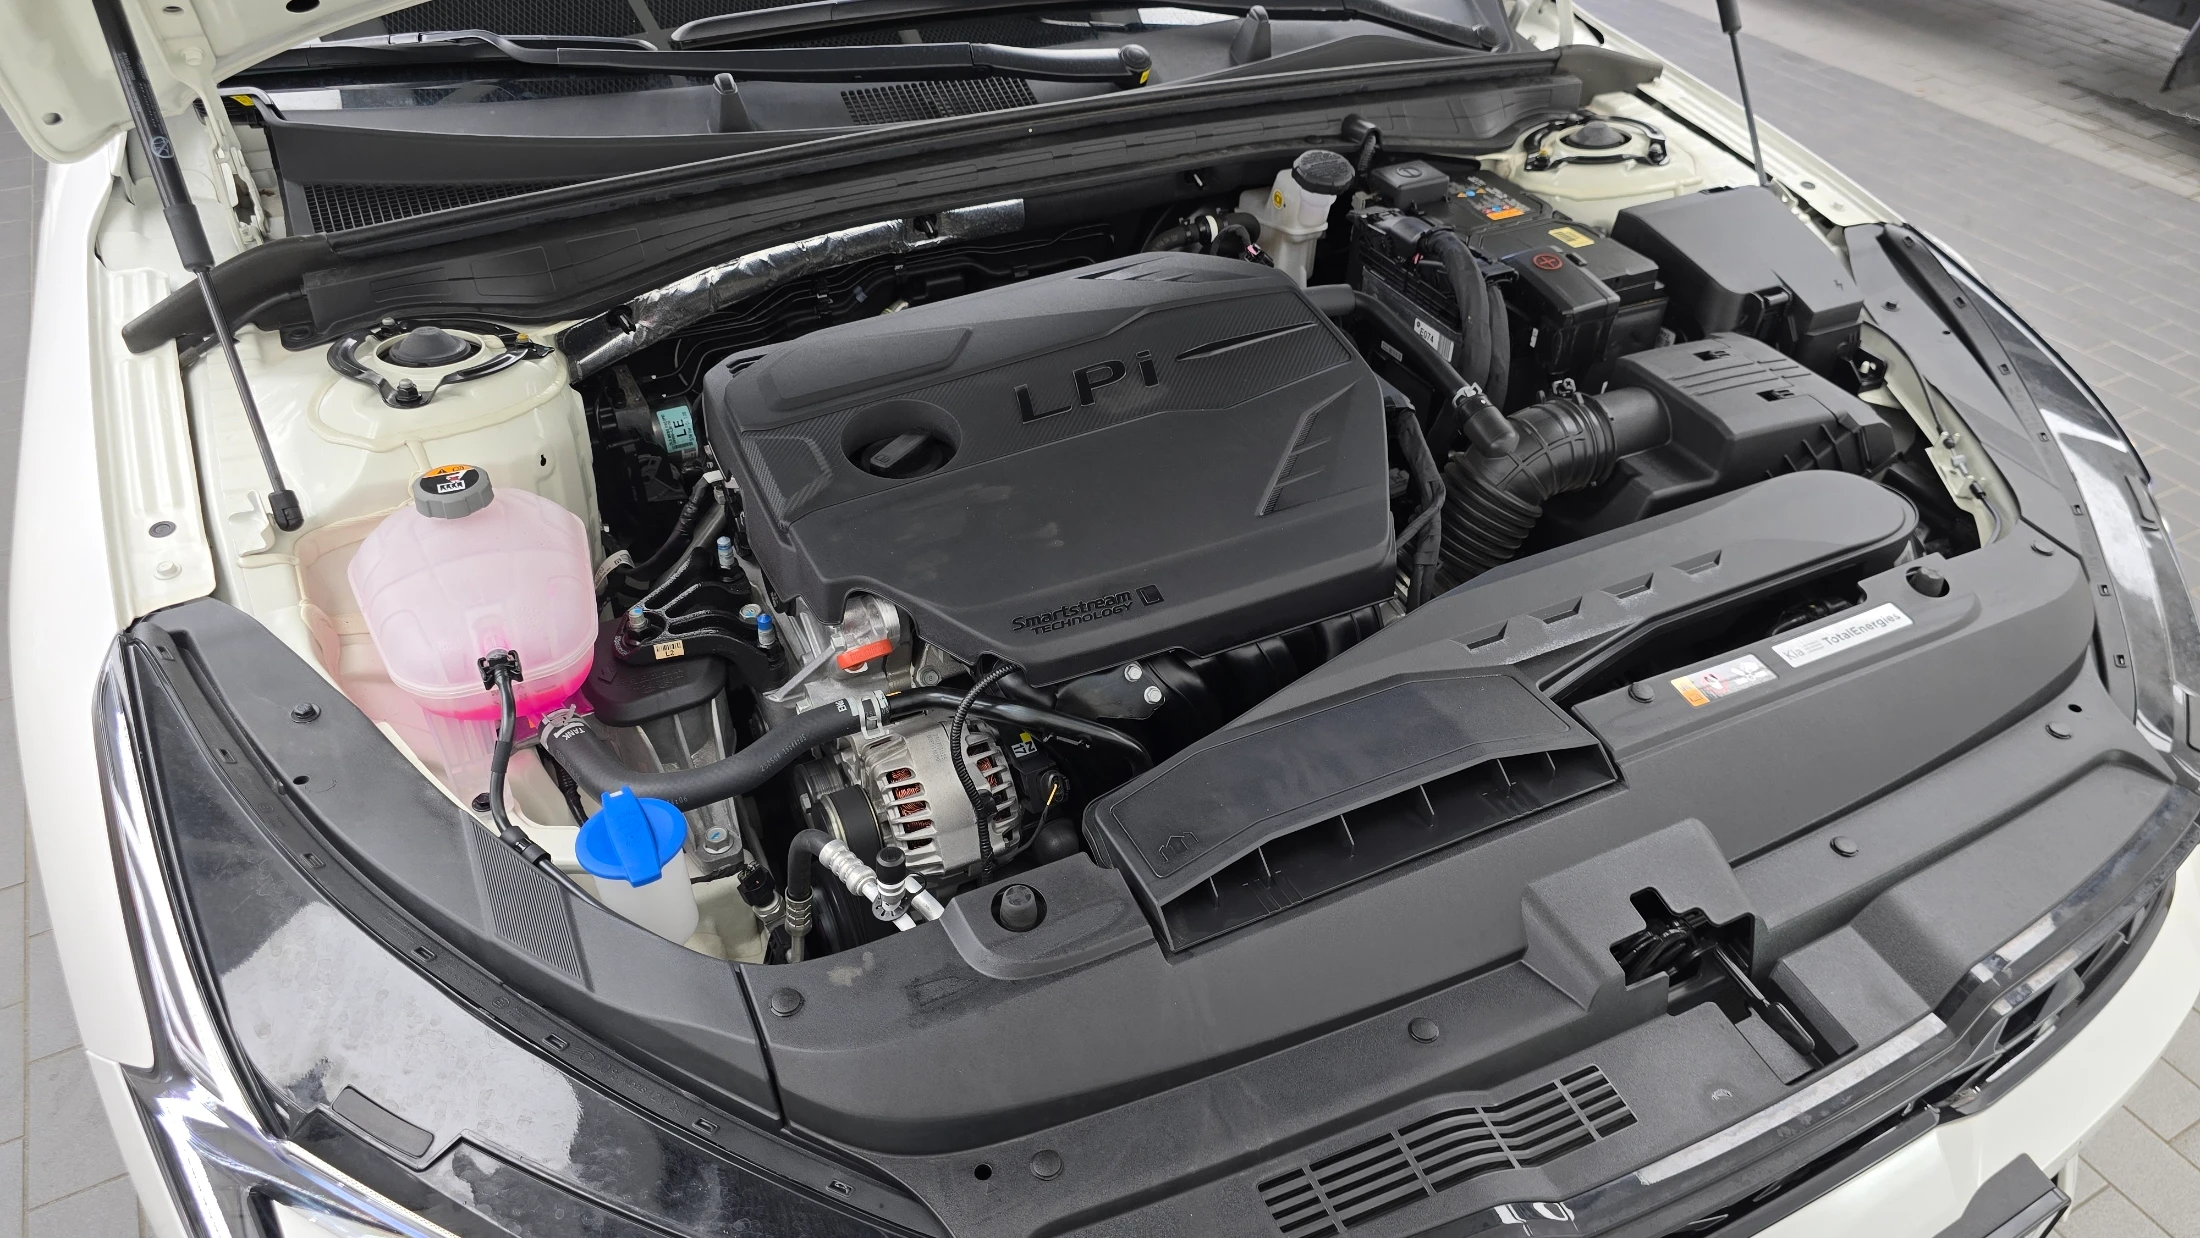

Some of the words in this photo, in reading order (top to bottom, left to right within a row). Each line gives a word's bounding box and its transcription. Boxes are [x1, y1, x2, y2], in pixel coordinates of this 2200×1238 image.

[1013, 349, 1160, 424] LPi
[672, 419, 687, 438] LE
[1011, 590, 1133, 631] Smartstream
[1030, 602, 1133, 635] TECHNOLOGY
[1821, 612, 1901, 647] TotalEnergies
[561, 726, 586, 741] TANK
